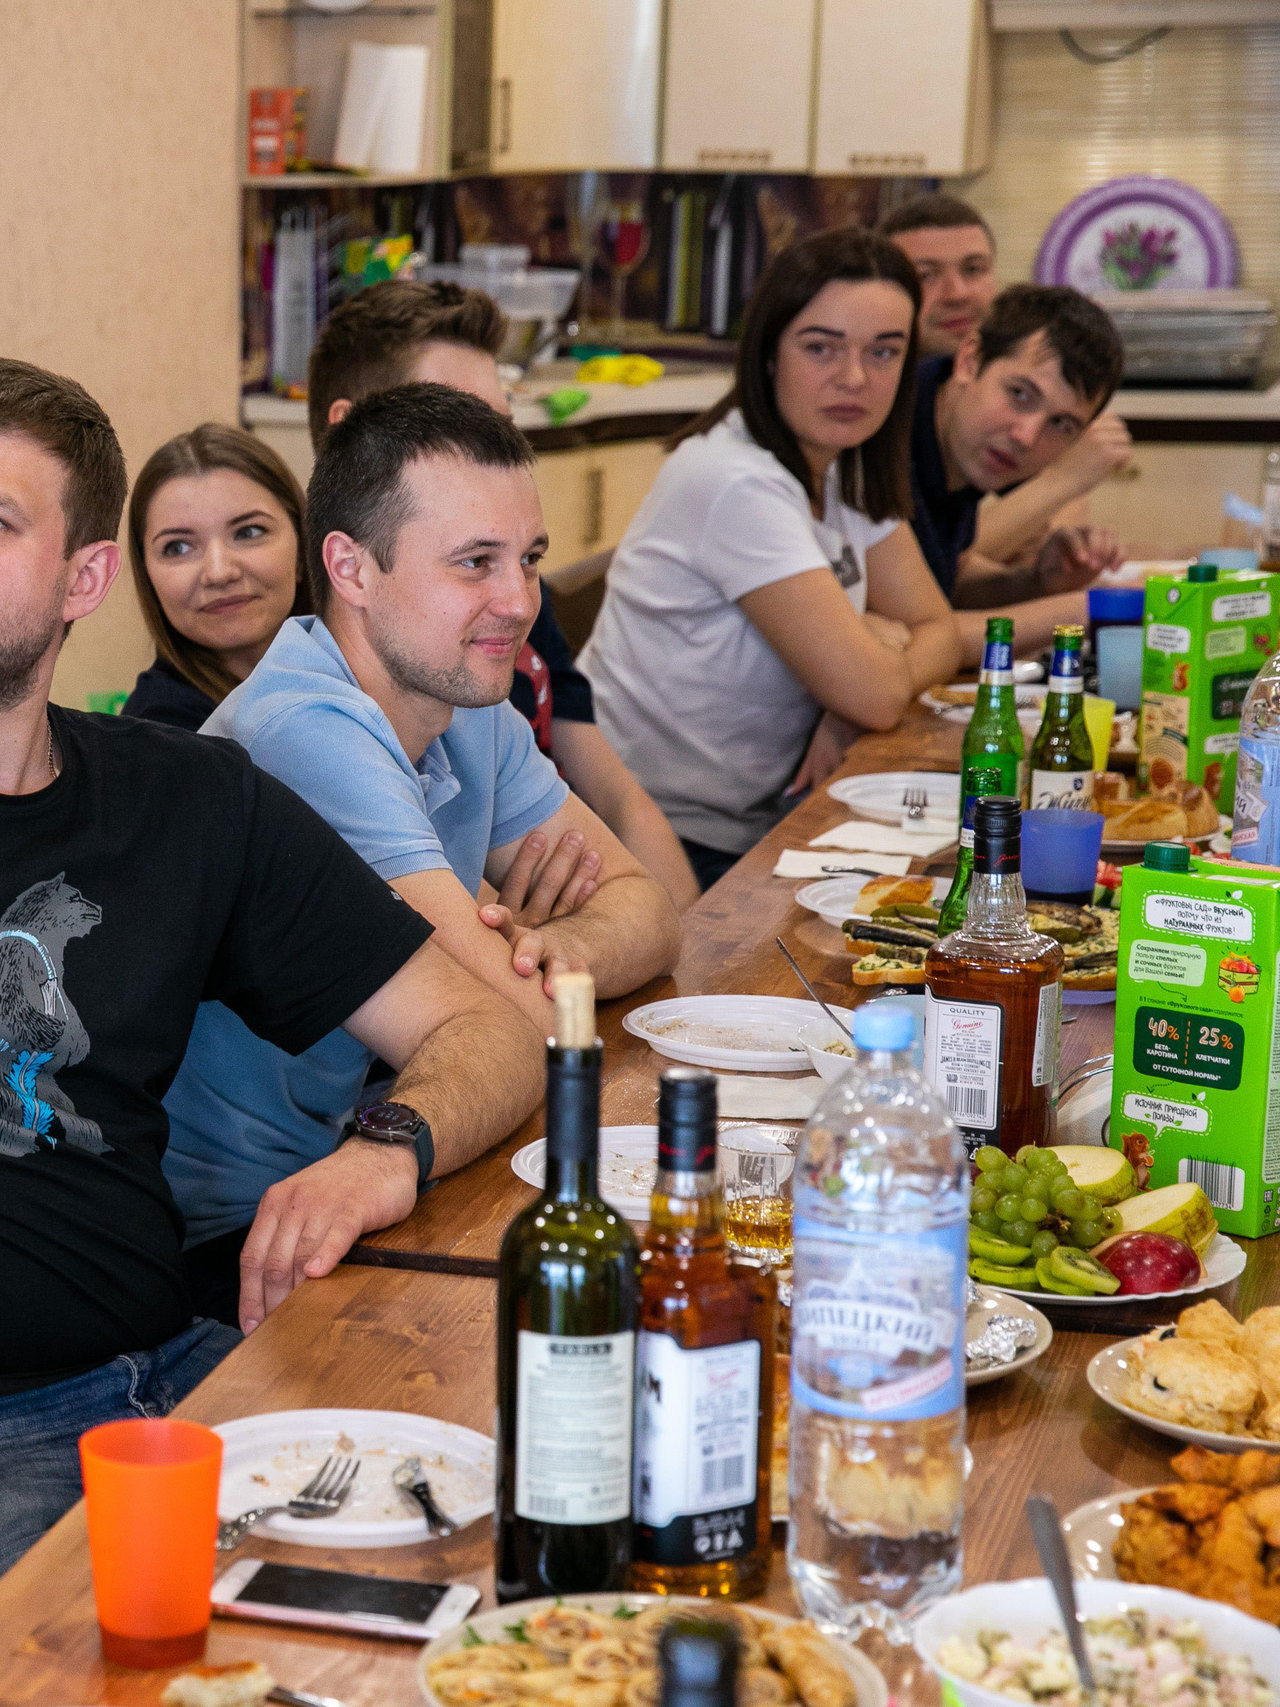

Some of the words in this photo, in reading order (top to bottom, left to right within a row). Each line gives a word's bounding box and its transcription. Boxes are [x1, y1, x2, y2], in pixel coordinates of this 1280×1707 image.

[1194, 903, 1212, 913] САД»
[1177, 911, 1199, 921] ПОТОМУ
[1214, 916, 1222, 924] ИЗ
[1205, 924, 1235, 935] ФРУКТОВ!
[1136, 944, 1170, 953] Сохраняем
[1170, 950, 1201, 960] природную
[1163, 964, 1186, 972] фруктов
[950, 1007, 985, 1016] QUALITY
[1148, 1016, 1180, 1041] 40%
[1199, 1026, 1234, 1050] 25%
[1154, 1043, 1171, 1051] БЕТА-
[1146, 1049, 1178, 1060] КАРОТИНА
[1195, 1053, 1230, 1065] КЛЕТЧАТКИ
[1161, 1065, 1194, 1077] СУТОЧНОЙ
[1135, 1098, 1163, 1112] ИСТОЧНИК
[1164, 1104, 1198, 1118] ПРИРОДНОЙ
[1152, 1112, 1174, 1123] ПОЛЬЗЫ
